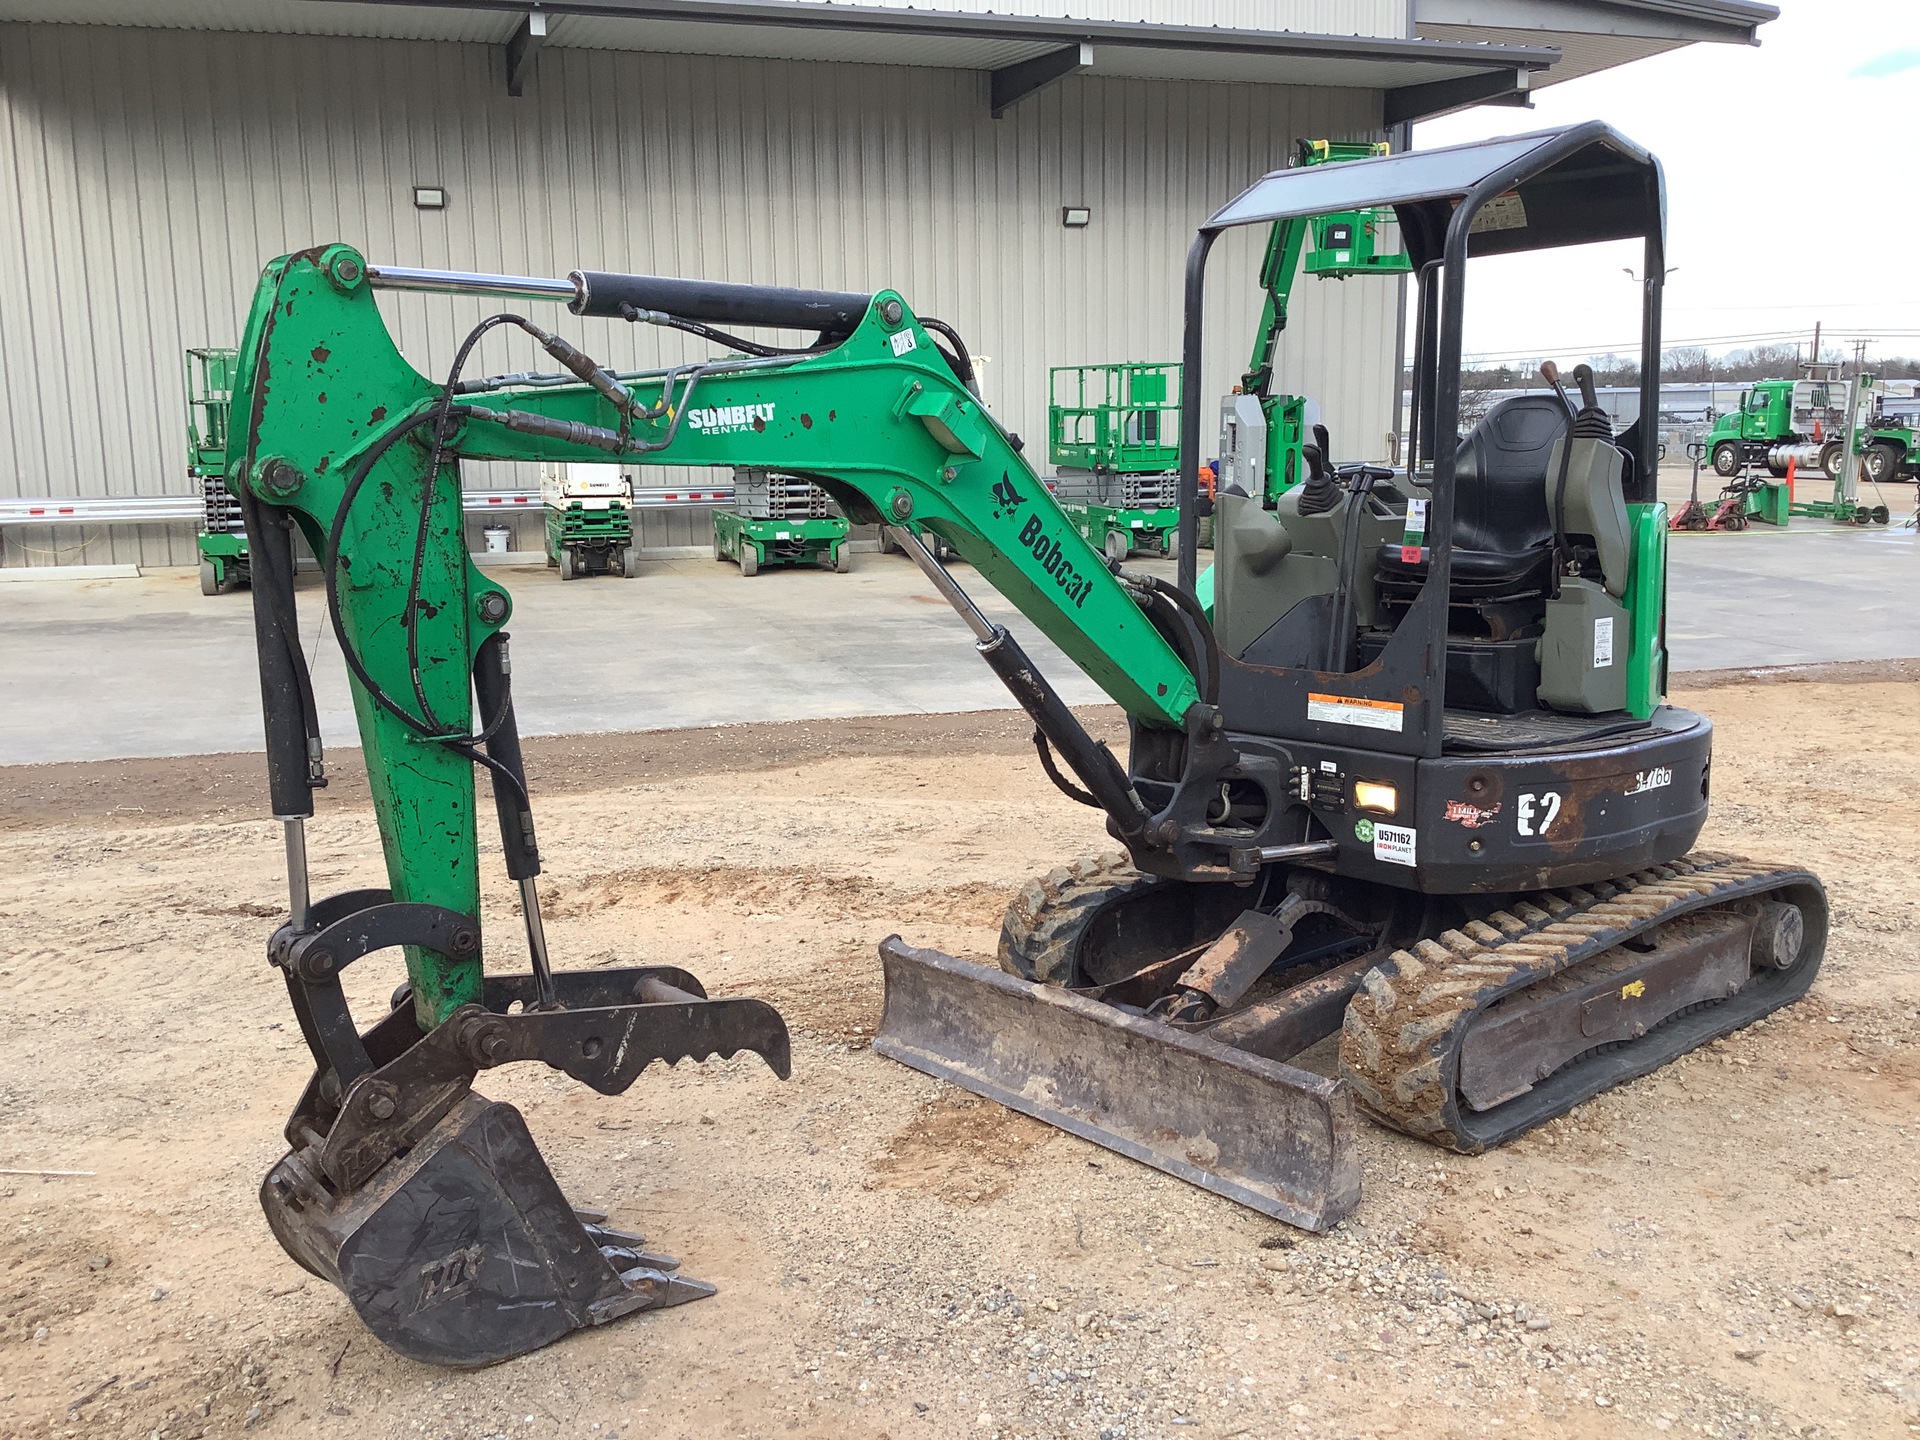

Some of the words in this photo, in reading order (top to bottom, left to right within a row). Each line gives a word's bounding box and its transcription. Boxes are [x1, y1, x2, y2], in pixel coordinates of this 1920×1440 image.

[688, 402, 776, 429] SUNBELT
[1018, 513, 1093, 609] Bobcat
[1344, 698, 1373, 707] WARNING
[1378, 829, 1411, 845] U571162
